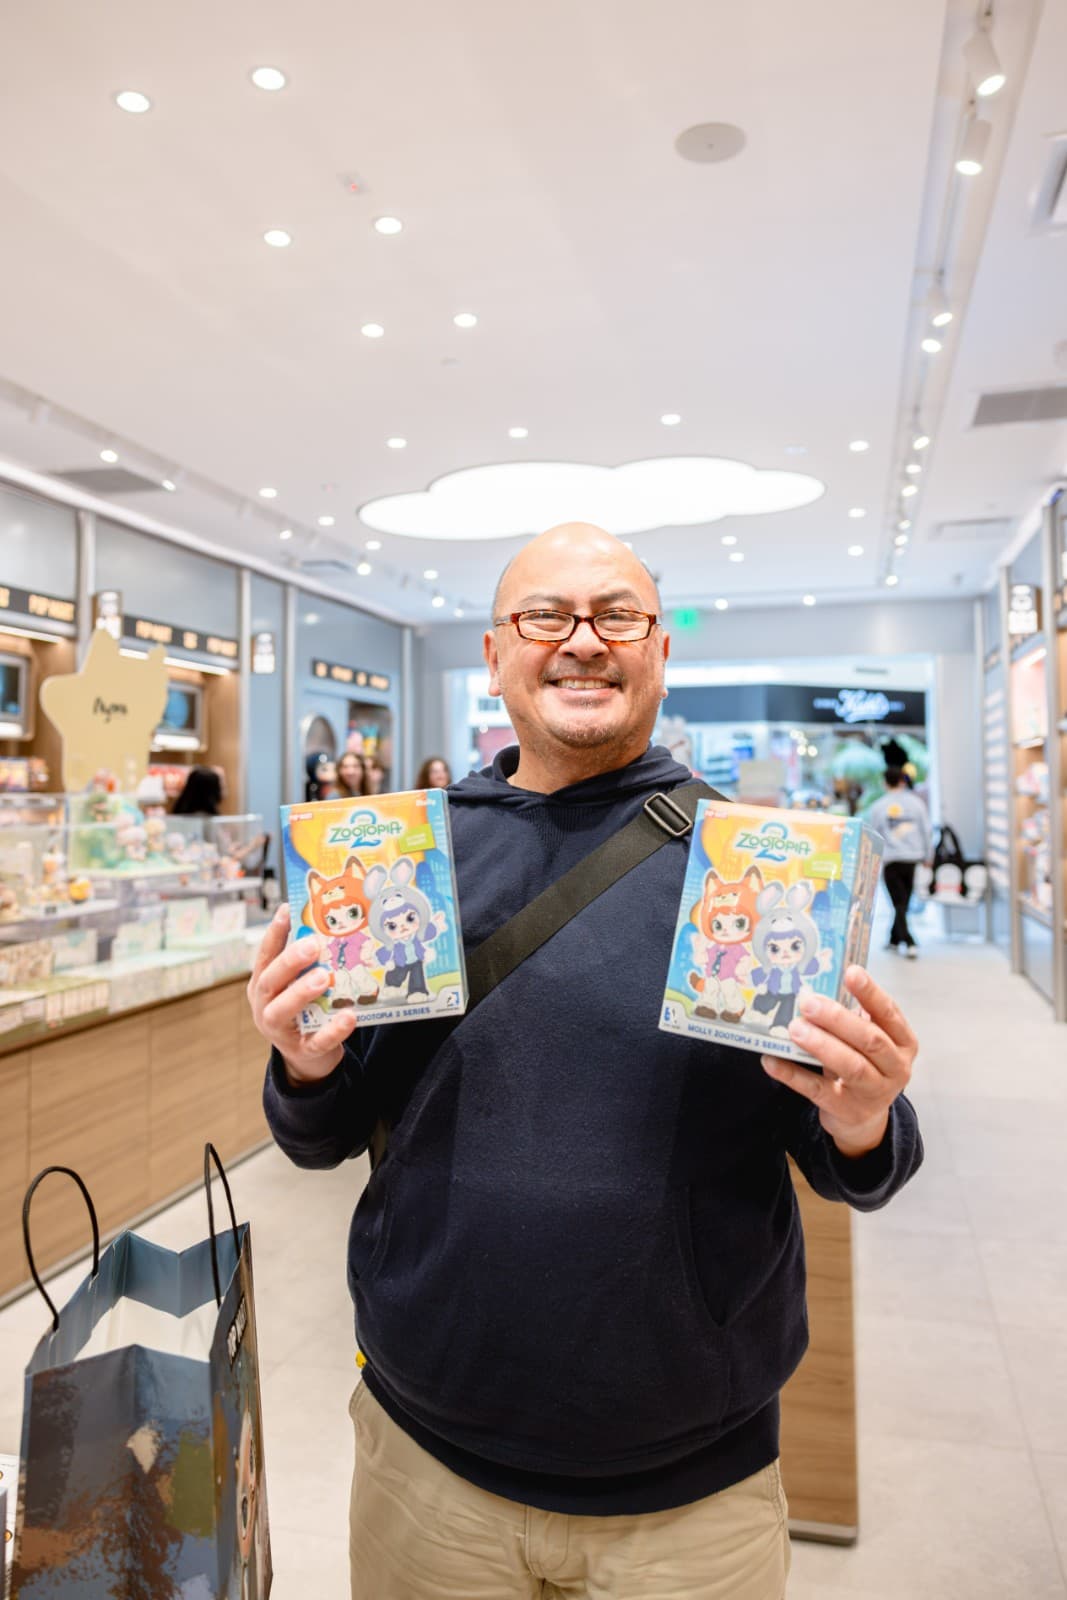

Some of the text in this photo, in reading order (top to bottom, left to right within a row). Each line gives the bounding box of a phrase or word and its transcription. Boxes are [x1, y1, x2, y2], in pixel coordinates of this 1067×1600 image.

[328, 821, 403, 844] ZOOTOPIA
[735, 832, 812, 856] ZOOTOPIA
[356, 1012, 393, 1022] ZOOTOPIA
[403, 1007, 431, 1017] SERIES
[688, 1023, 713, 1037] MOLLY
[714, 1029, 752, 1045] ZOOTOPIA
[762, 1041, 791, 1054] SERIES
